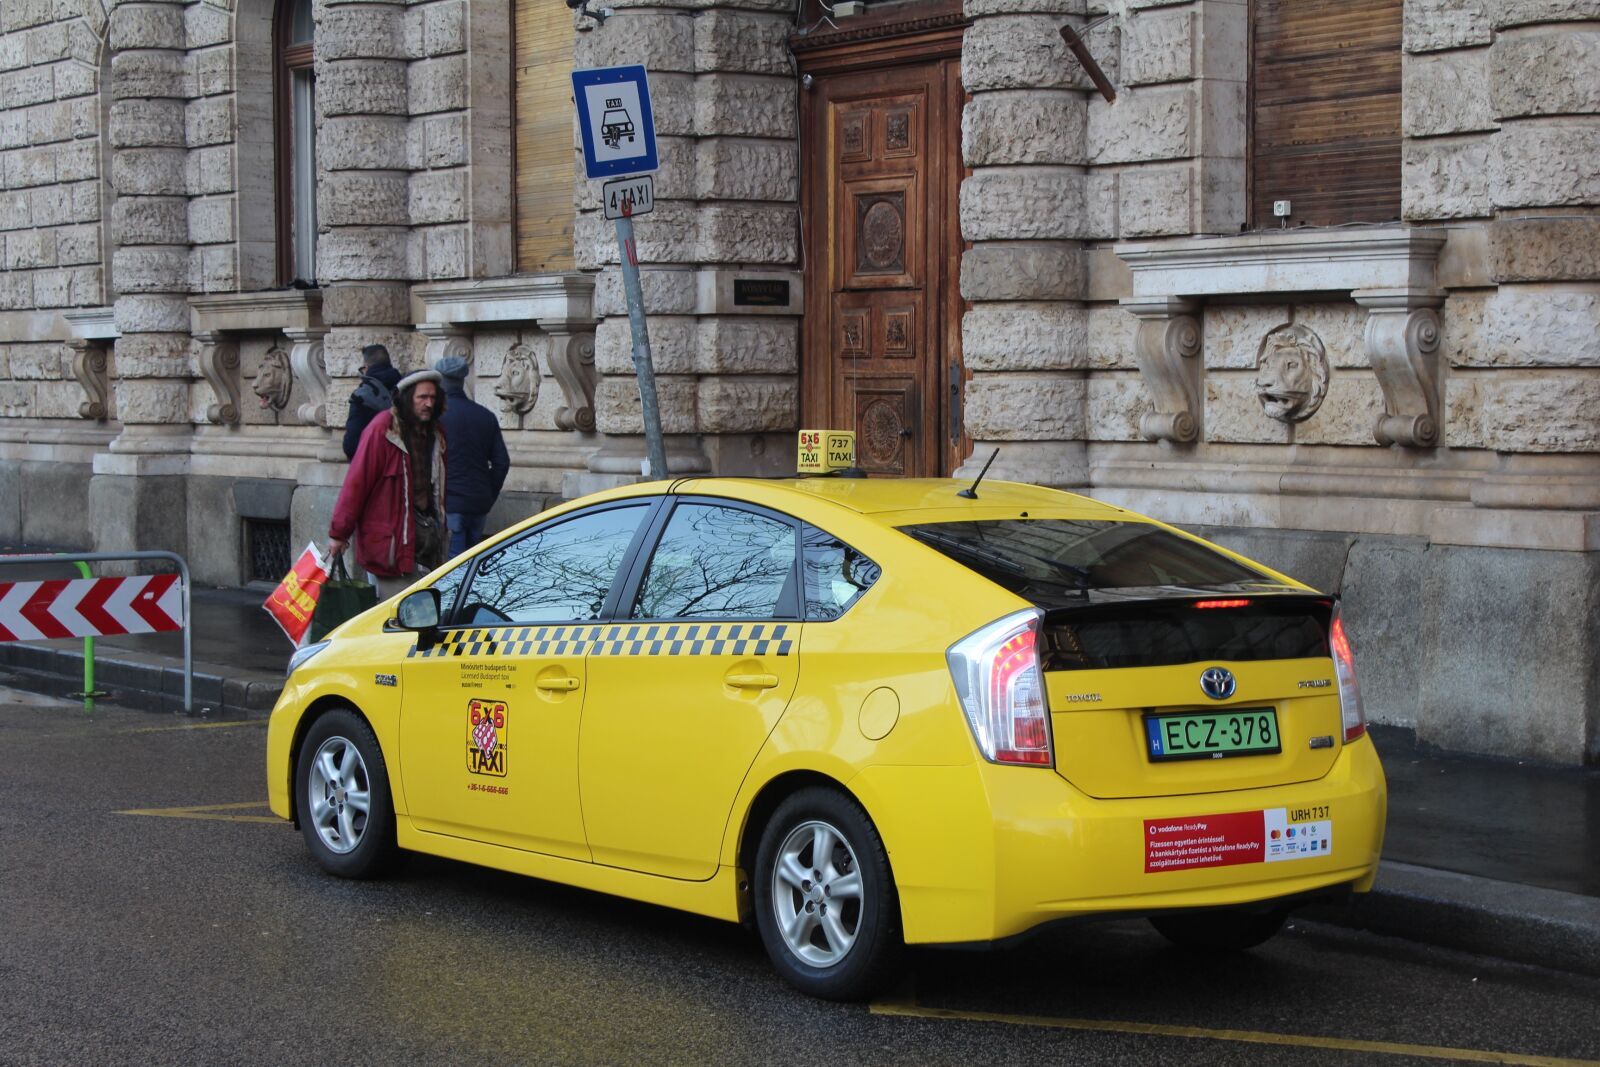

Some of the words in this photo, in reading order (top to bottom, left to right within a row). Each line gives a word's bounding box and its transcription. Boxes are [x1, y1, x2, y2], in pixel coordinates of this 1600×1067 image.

[606, 99, 622, 107] TAXI
[610, 191, 617, 210] 4
[621, 185, 649, 209] TAXI
[831, 439, 848, 448] 737
[801, 453, 818, 462] TAXI
[829, 452, 852, 461] TAXI
[1065, 693, 1102, 703] TOYOTA
[1165, 716, 1272, 751] ECZ-378
[1153, 739, 1160, 750] H
[469, 747, 504, 774] TAXI
[1291, 808, 1311, 822] URH
[1312, 806, 1329, 819] 737
[1158, 824, 1183, 833] vodafone
[1184, 822, 1207, 832] ReadyPay
[1150, 840, 1174, 848] Fizessen
[1174, 837, 1198, 848] egyetlen
[1198, 835, 1225, 844] érintéssel!
[1188, 846, 1208, 855] fizetést
[1212, 844, 1236, 853] Vodafone
[1236, 841, 1260, 851] ReadyPay
[1186, 856, 1199, 864] teszi
